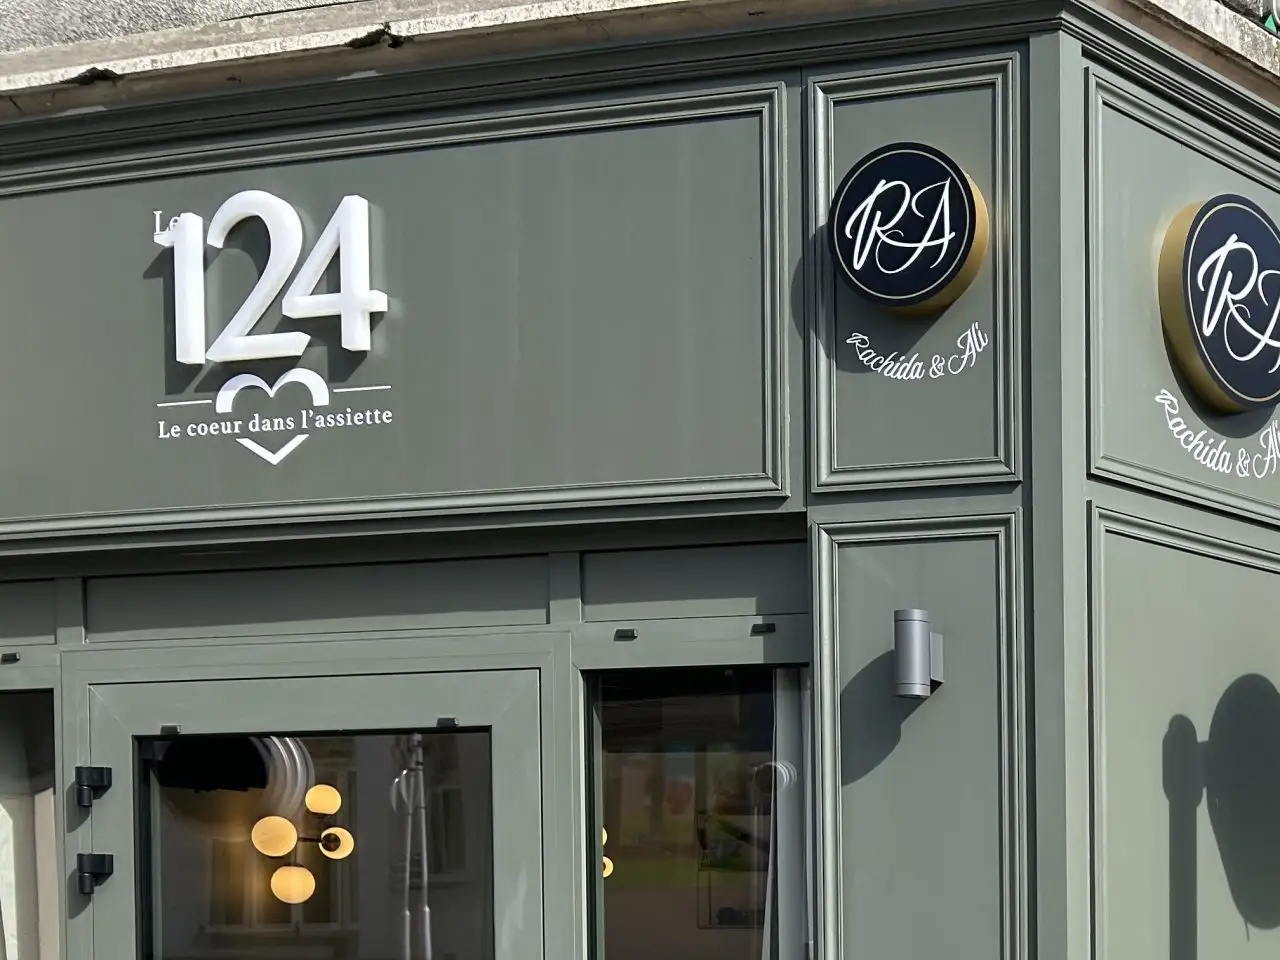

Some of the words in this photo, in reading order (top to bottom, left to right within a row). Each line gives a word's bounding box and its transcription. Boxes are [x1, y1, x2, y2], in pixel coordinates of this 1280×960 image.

[153, 210, 181, 235] Le
[845, 177, 956, 274] RA
[153, 189, 388, 364] 124
[846, 332, 925, 380] Rachida
[928, 354, 945, 378] &
[948, 321, 988, 374] Ali
[158, 420, 181, 439] Le
[187, 417, 242, 436] coeur
[248, 413, 295, 433] dans
[300, 407, 393, 429] l’assiette
[1154, 389, 1233, 474] Rachida
[1235, 448, 1251, 477] &
